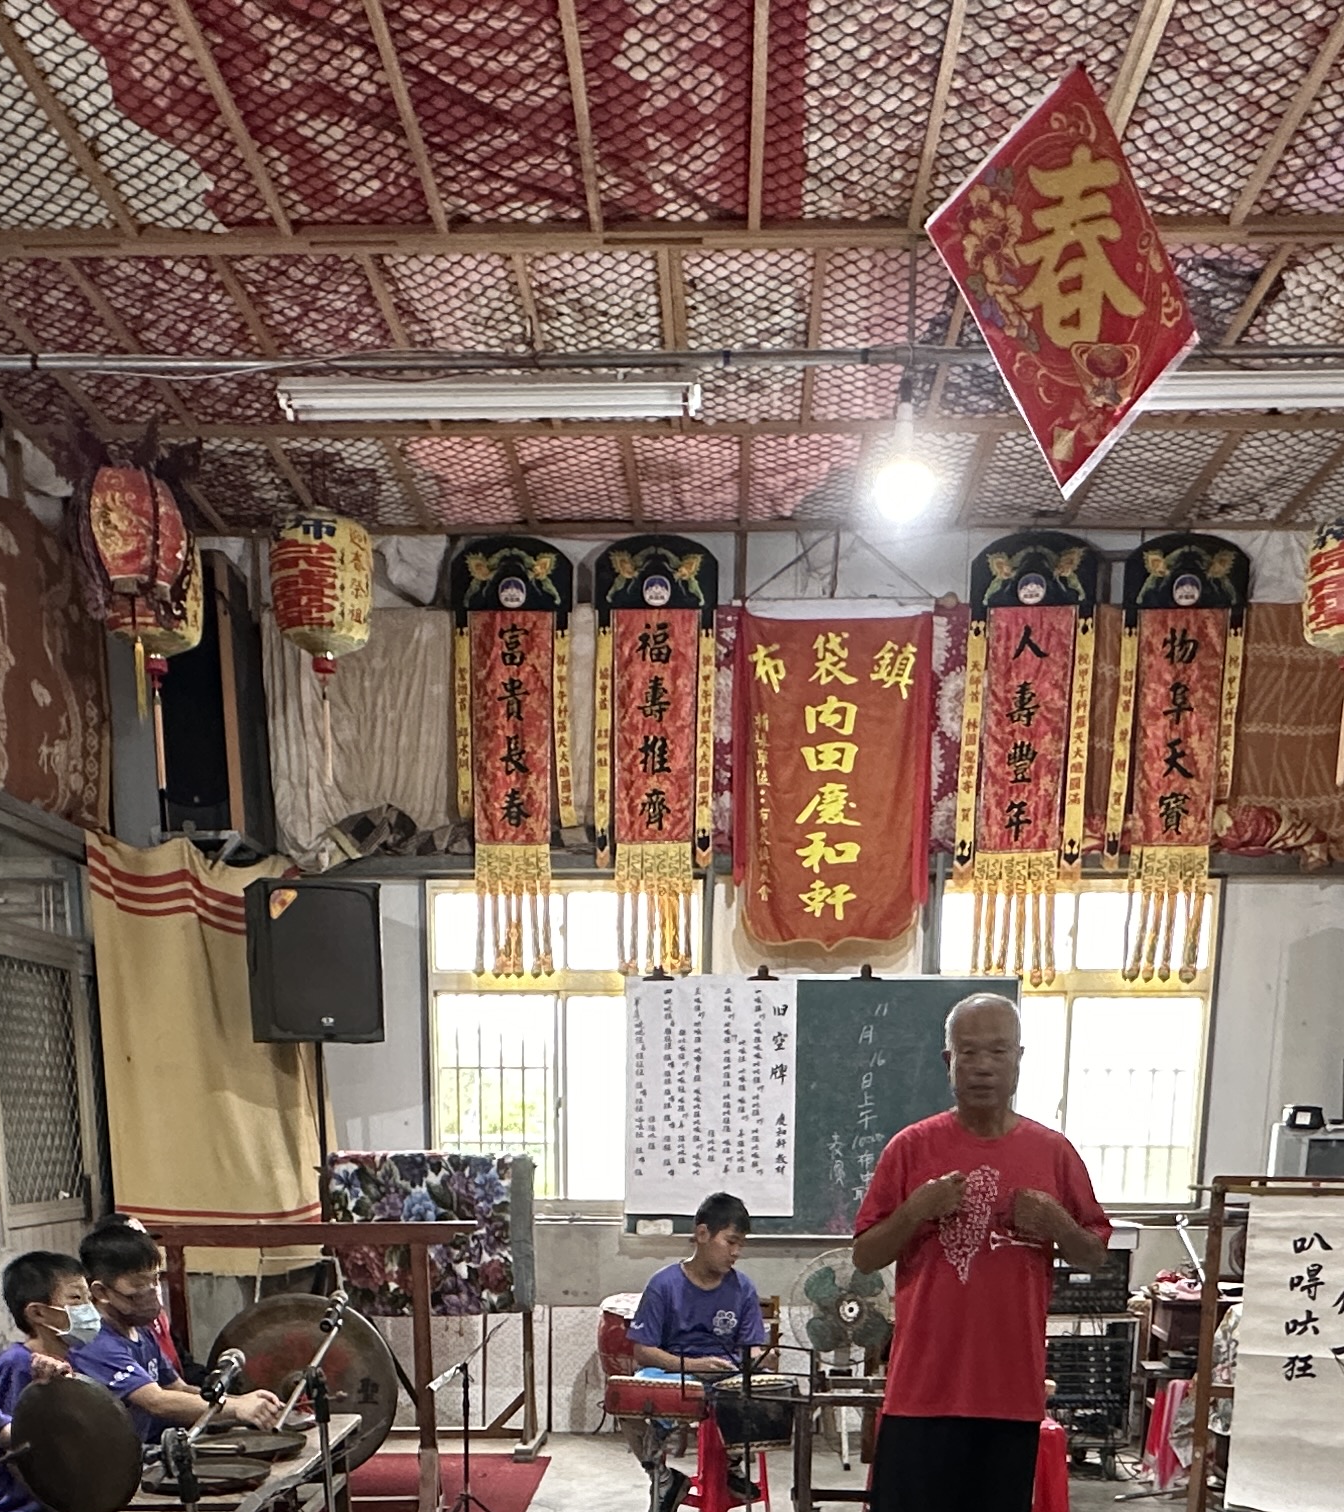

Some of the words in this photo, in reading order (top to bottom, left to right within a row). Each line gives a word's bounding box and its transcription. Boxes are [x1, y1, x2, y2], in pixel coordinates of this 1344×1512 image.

[1014, 143, 1146, 350] 春
[497, 622, 532, 828] 富貴長春
[1006, 624, 1049, 842] 人壽豐年
